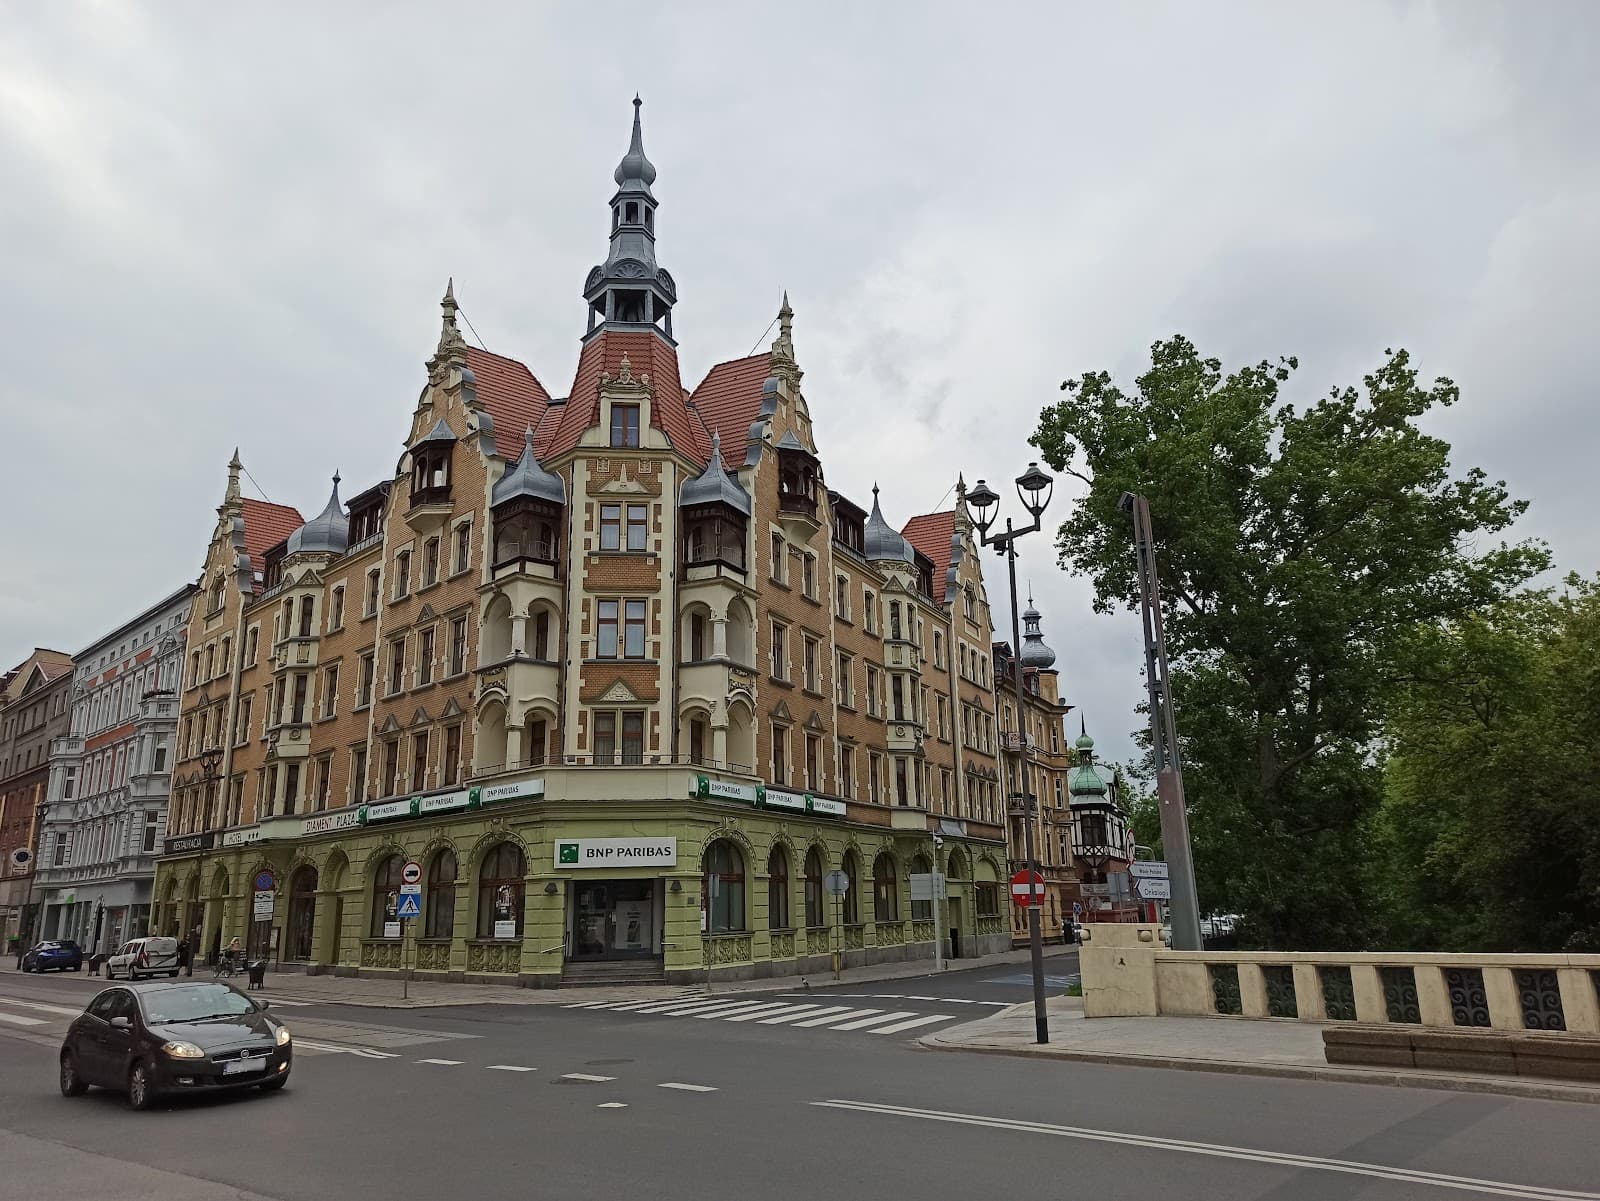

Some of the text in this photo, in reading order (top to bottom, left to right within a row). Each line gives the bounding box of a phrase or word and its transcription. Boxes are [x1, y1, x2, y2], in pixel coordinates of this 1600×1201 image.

[487, 785, 519, 799] BNP PARIBAS
[711, 783, 741, 795] BNP PARIBAS
[306, 812, 356, 833] DIAMENT PLAZA
[228, 832, 242, 844] HOTEL
[173, 838, 202, 851] RESTAURACJA
[586, 846, 672, 858] BNP PARIBAS
